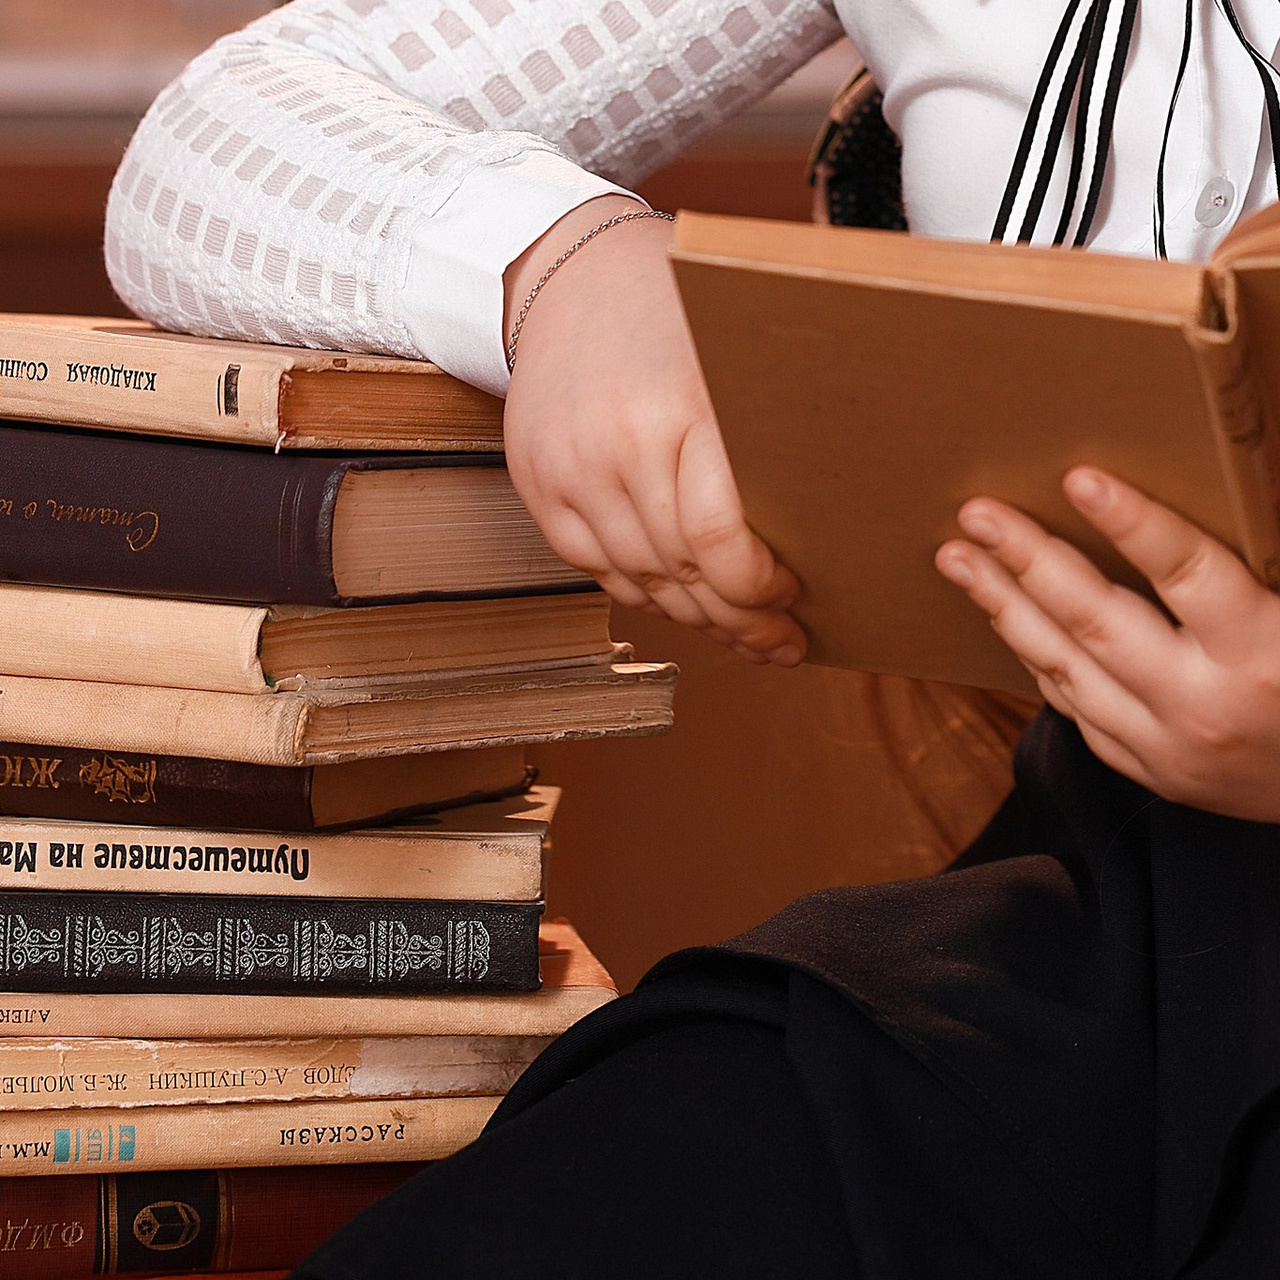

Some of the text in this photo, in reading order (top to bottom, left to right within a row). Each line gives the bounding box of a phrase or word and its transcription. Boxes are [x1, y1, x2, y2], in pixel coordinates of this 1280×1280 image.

[66, 362, 158, 391] КЛАДОВАЯ
[23, 501, 37, 519] о
[46, 499, 159, 552] Статьи
[49, 842, 84, 868] на
[94, 844, 310, 881] Путешествие
[279, 1123, 406, 1146] РАССКАЗЫ
